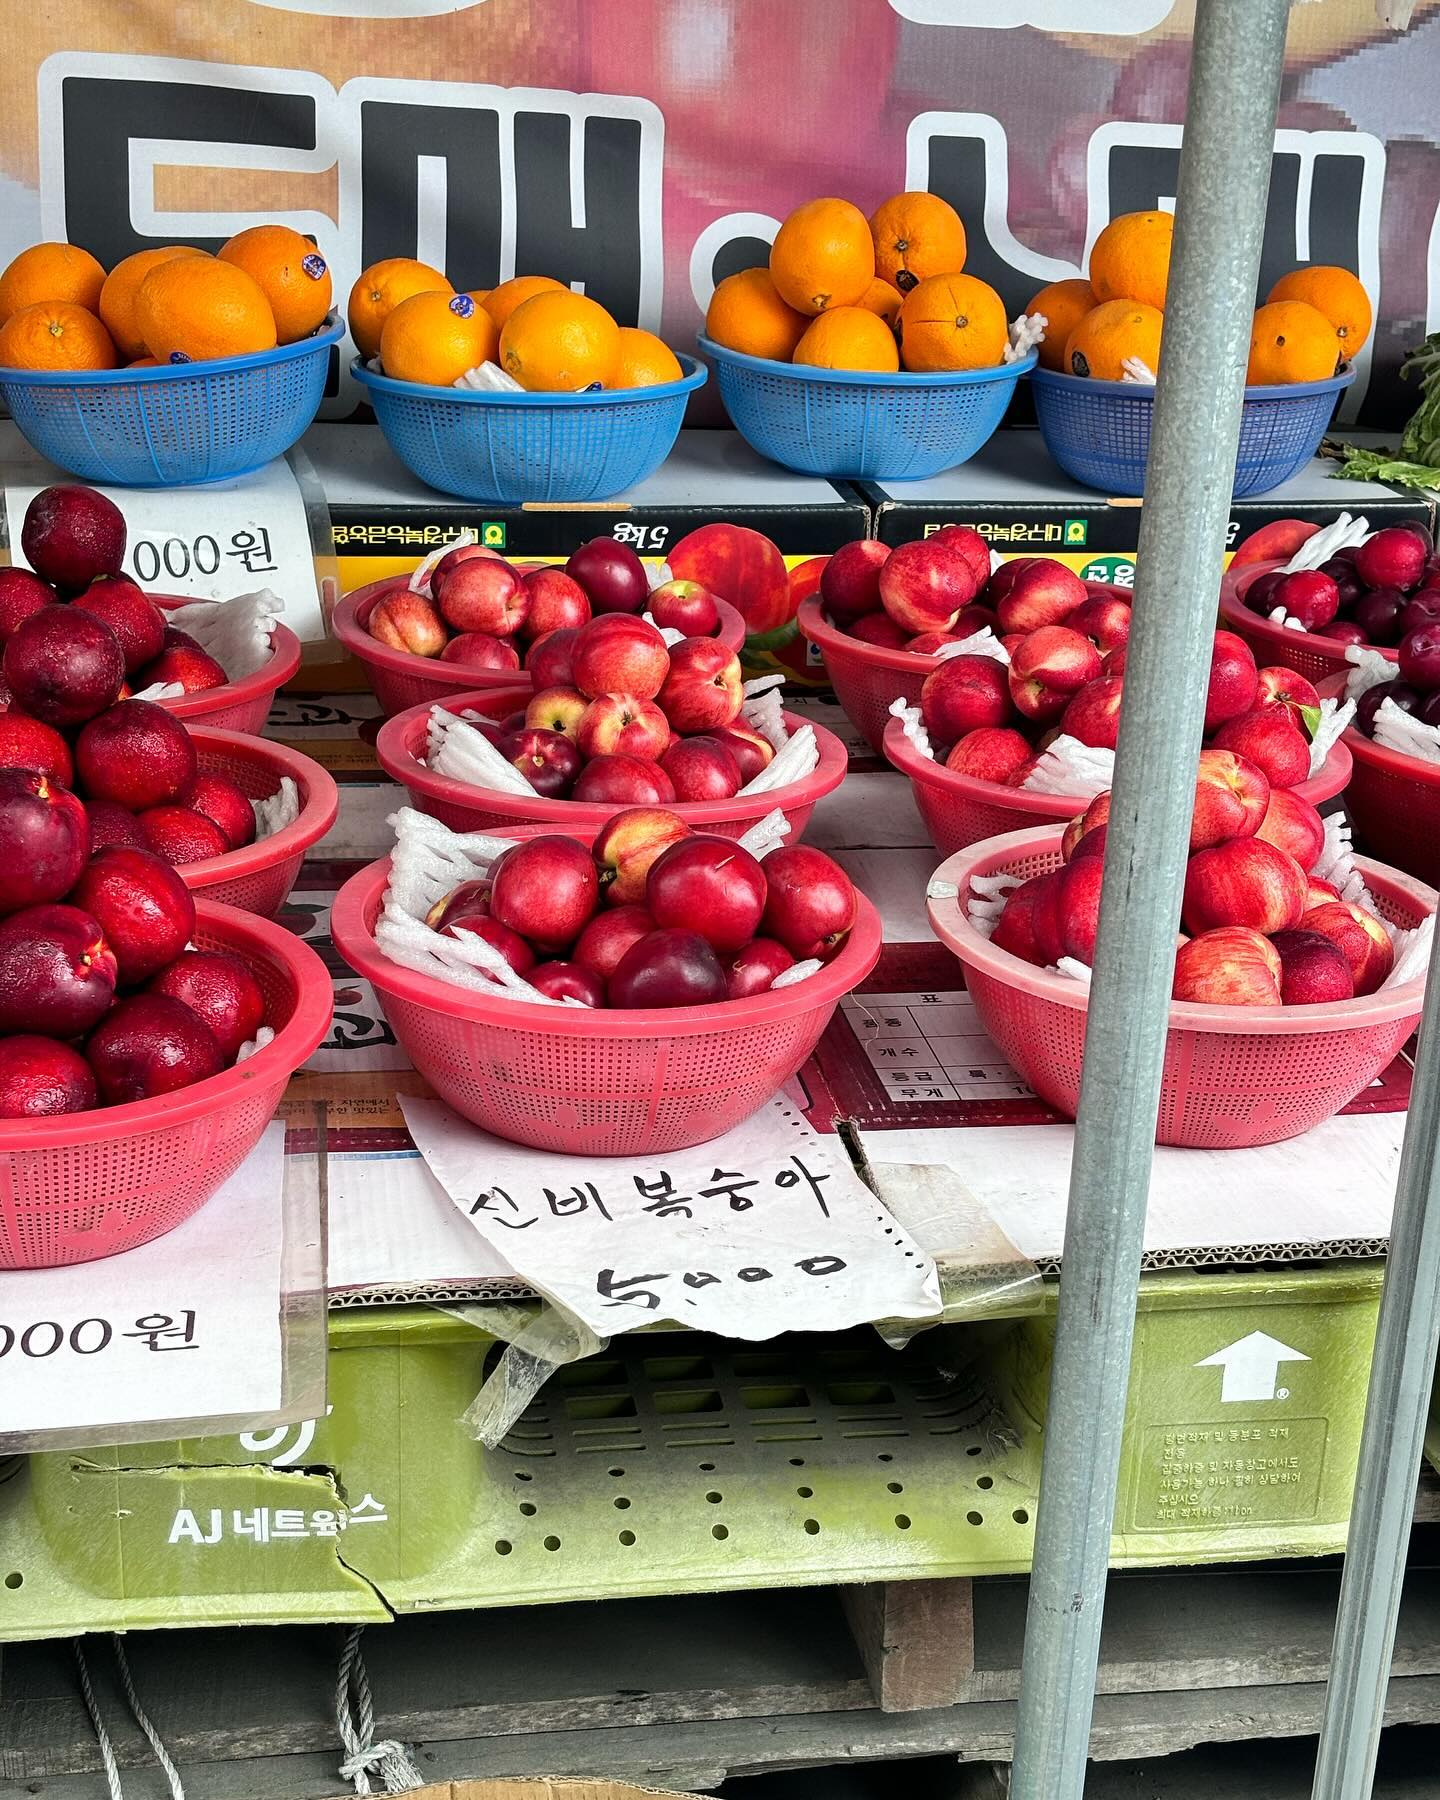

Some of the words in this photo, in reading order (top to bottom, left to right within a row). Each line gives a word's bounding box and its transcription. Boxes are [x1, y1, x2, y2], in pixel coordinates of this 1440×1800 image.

[612, 521, 670, 549] 5kg
[900, 1087, 944, 1099] 무게
[168, 1508, 223, 1545] AJ
